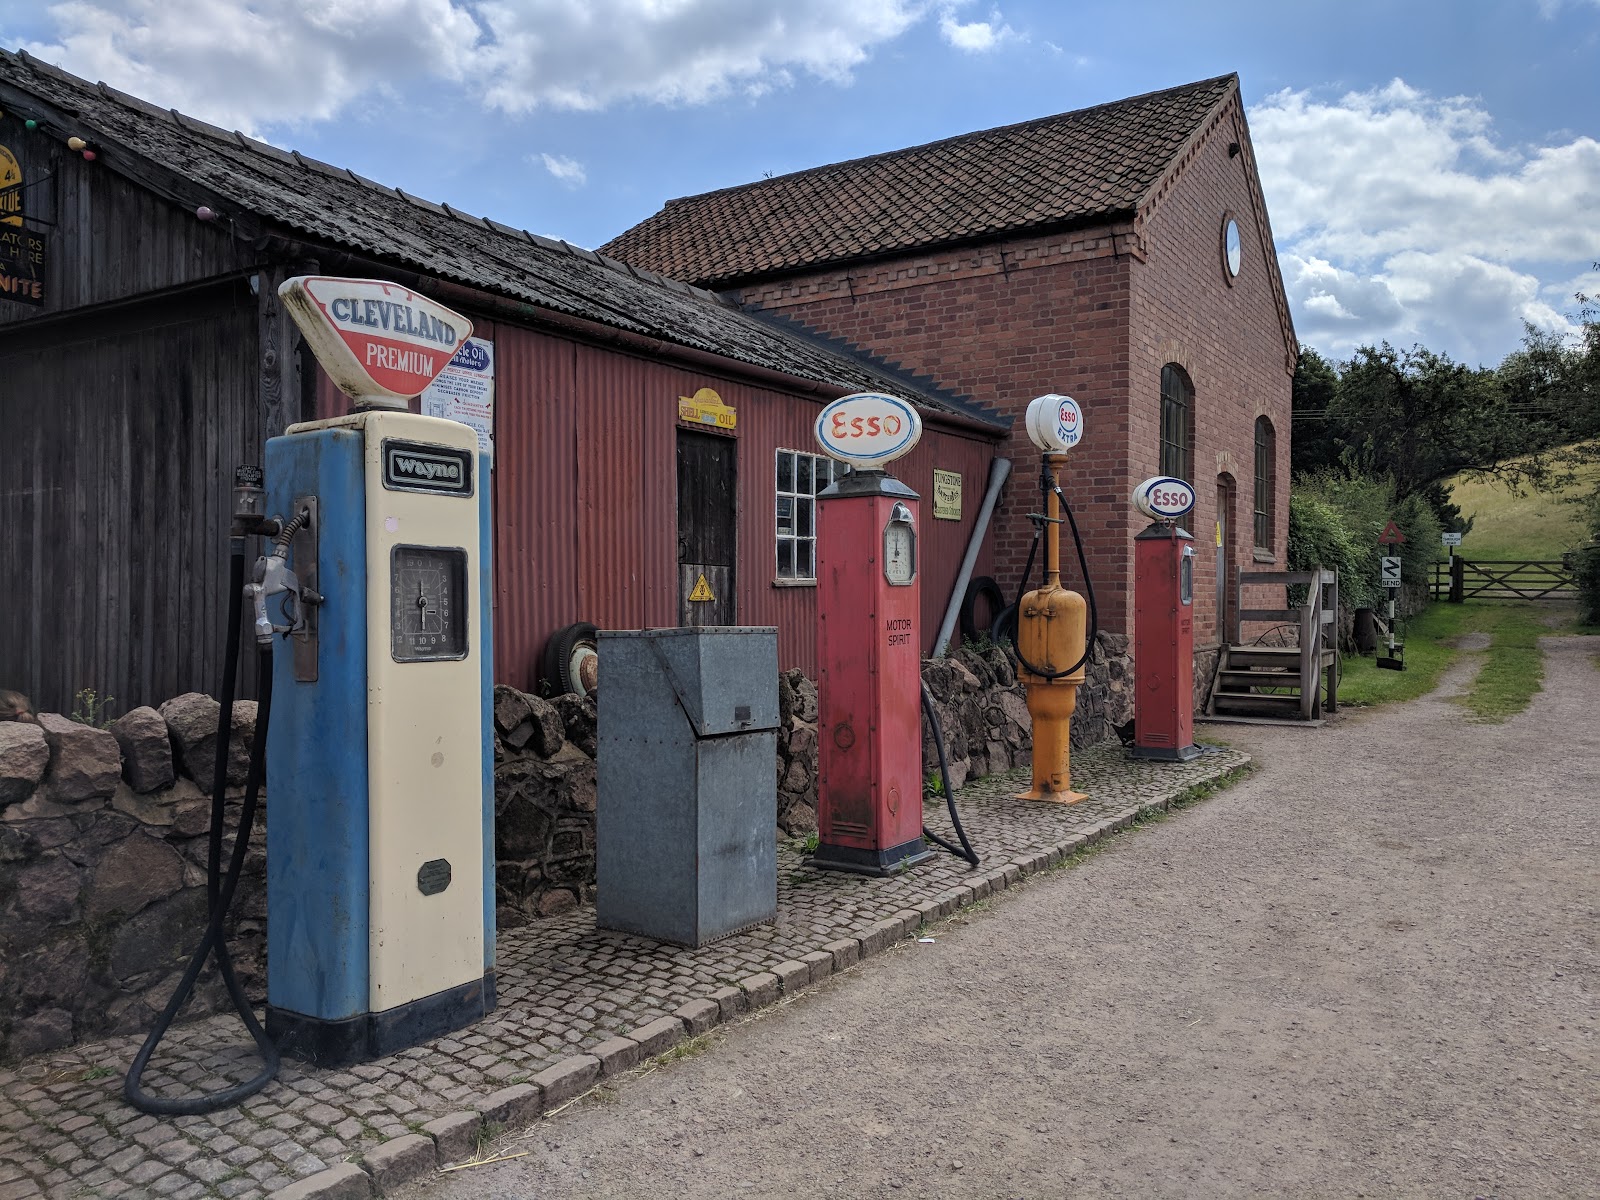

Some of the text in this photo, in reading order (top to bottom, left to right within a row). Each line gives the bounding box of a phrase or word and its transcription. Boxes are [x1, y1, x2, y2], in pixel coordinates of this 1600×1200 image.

[10, 246, 43, 264] HRE
[331, 298, 457, 347] CLEVELAND
[366, 343, 434, 378] PREMIUM
[472, 347, 485, 361] Oil
[460, 356, 482, 368] Motors
[719, 414, 734, 426] OIL
[1057, 427, 1078, 444] EXTRA
[396, 457, 459, 480] Wayne
[886, 619, 911, 631] MOTOR
[888, 633, 911, 646] SPIRIT
